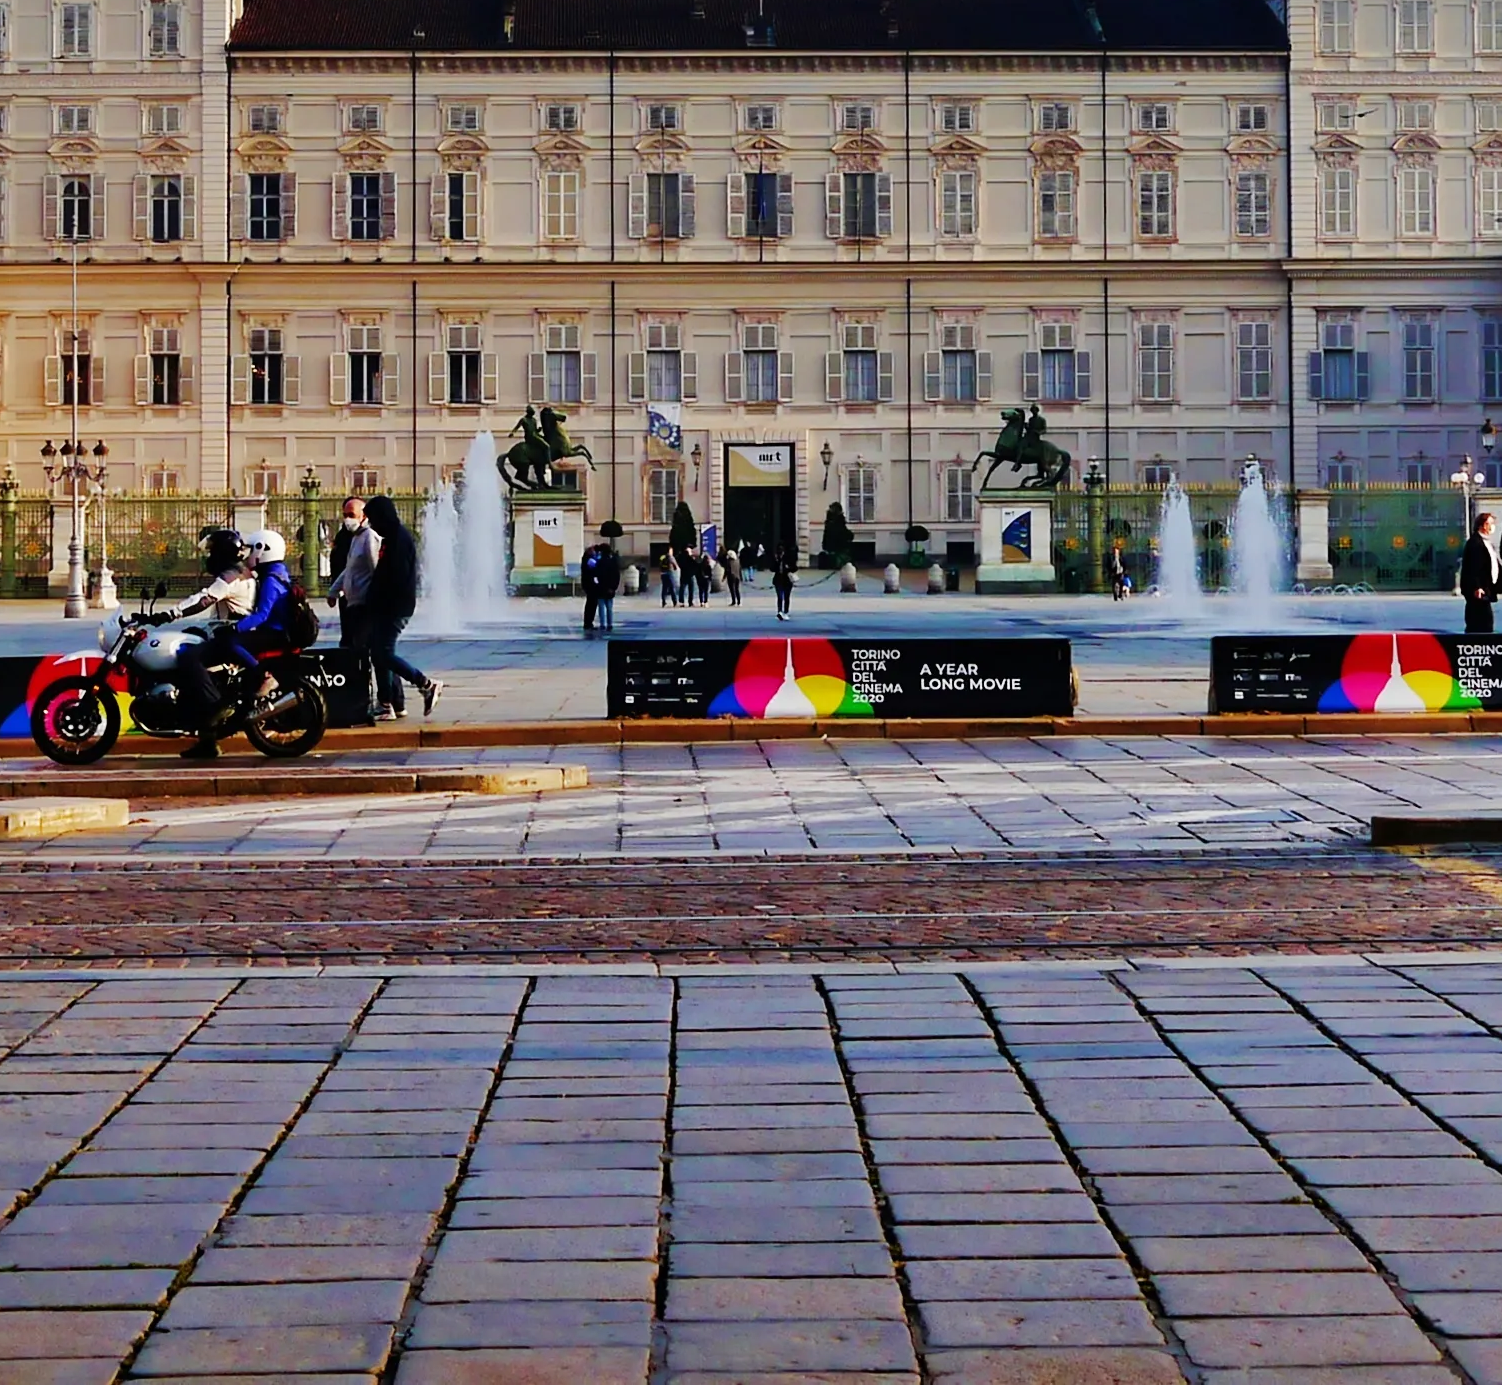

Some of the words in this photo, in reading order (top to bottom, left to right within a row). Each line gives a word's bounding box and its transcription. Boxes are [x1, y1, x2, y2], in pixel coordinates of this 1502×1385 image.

[851, 649, 901, 660] TORINO
[920, 663, 932, 676] A
[936, 663, 979, 676] YEAR
[1459, 667, 1483, 678] DEL
[305, 674, 346, 687] NGO
[852, 672, 877, 683] DEL
[852, 683, 904, 694] CINEMA
[921, 678, 965, 691] LONG
[970, 678, 1022, 691] MOVIE
[853, 694, 885, 703] 2020
[1460, 689, 1492, 698] 2020
